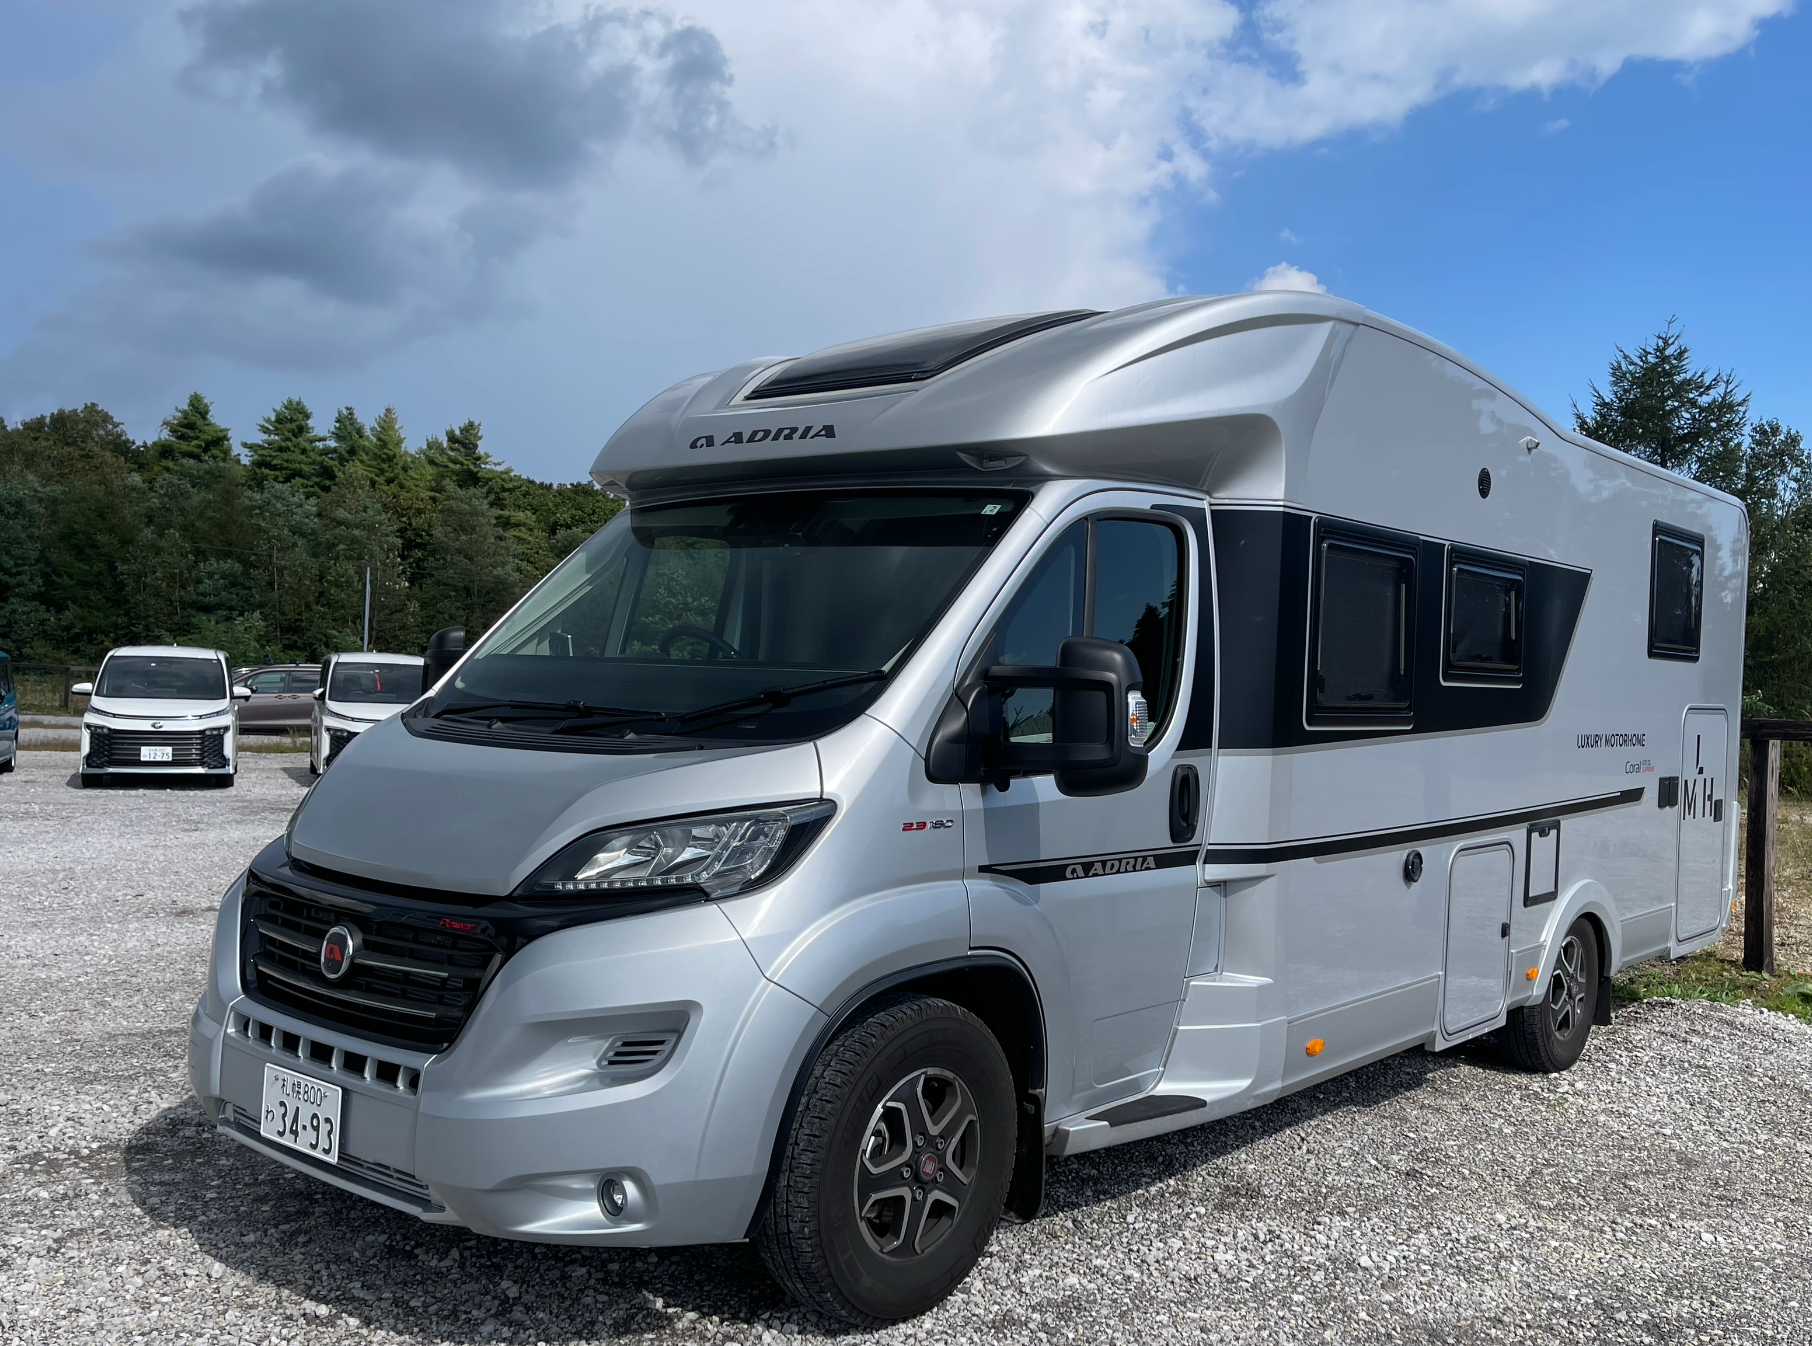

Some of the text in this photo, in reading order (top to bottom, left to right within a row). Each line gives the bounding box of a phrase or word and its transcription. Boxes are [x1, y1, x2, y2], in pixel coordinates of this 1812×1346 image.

[719, 424, 836, 447] ADRIA
[1576, 733, 1646, 749] LUXURY MOTORHOME
[1625, 760, 1642, 775] Coral
[1088, 856, 1157, 877] ADRIA
[439, 918, 476, 931] Power
[265, 1100, 334, 1155] わ 34-93
